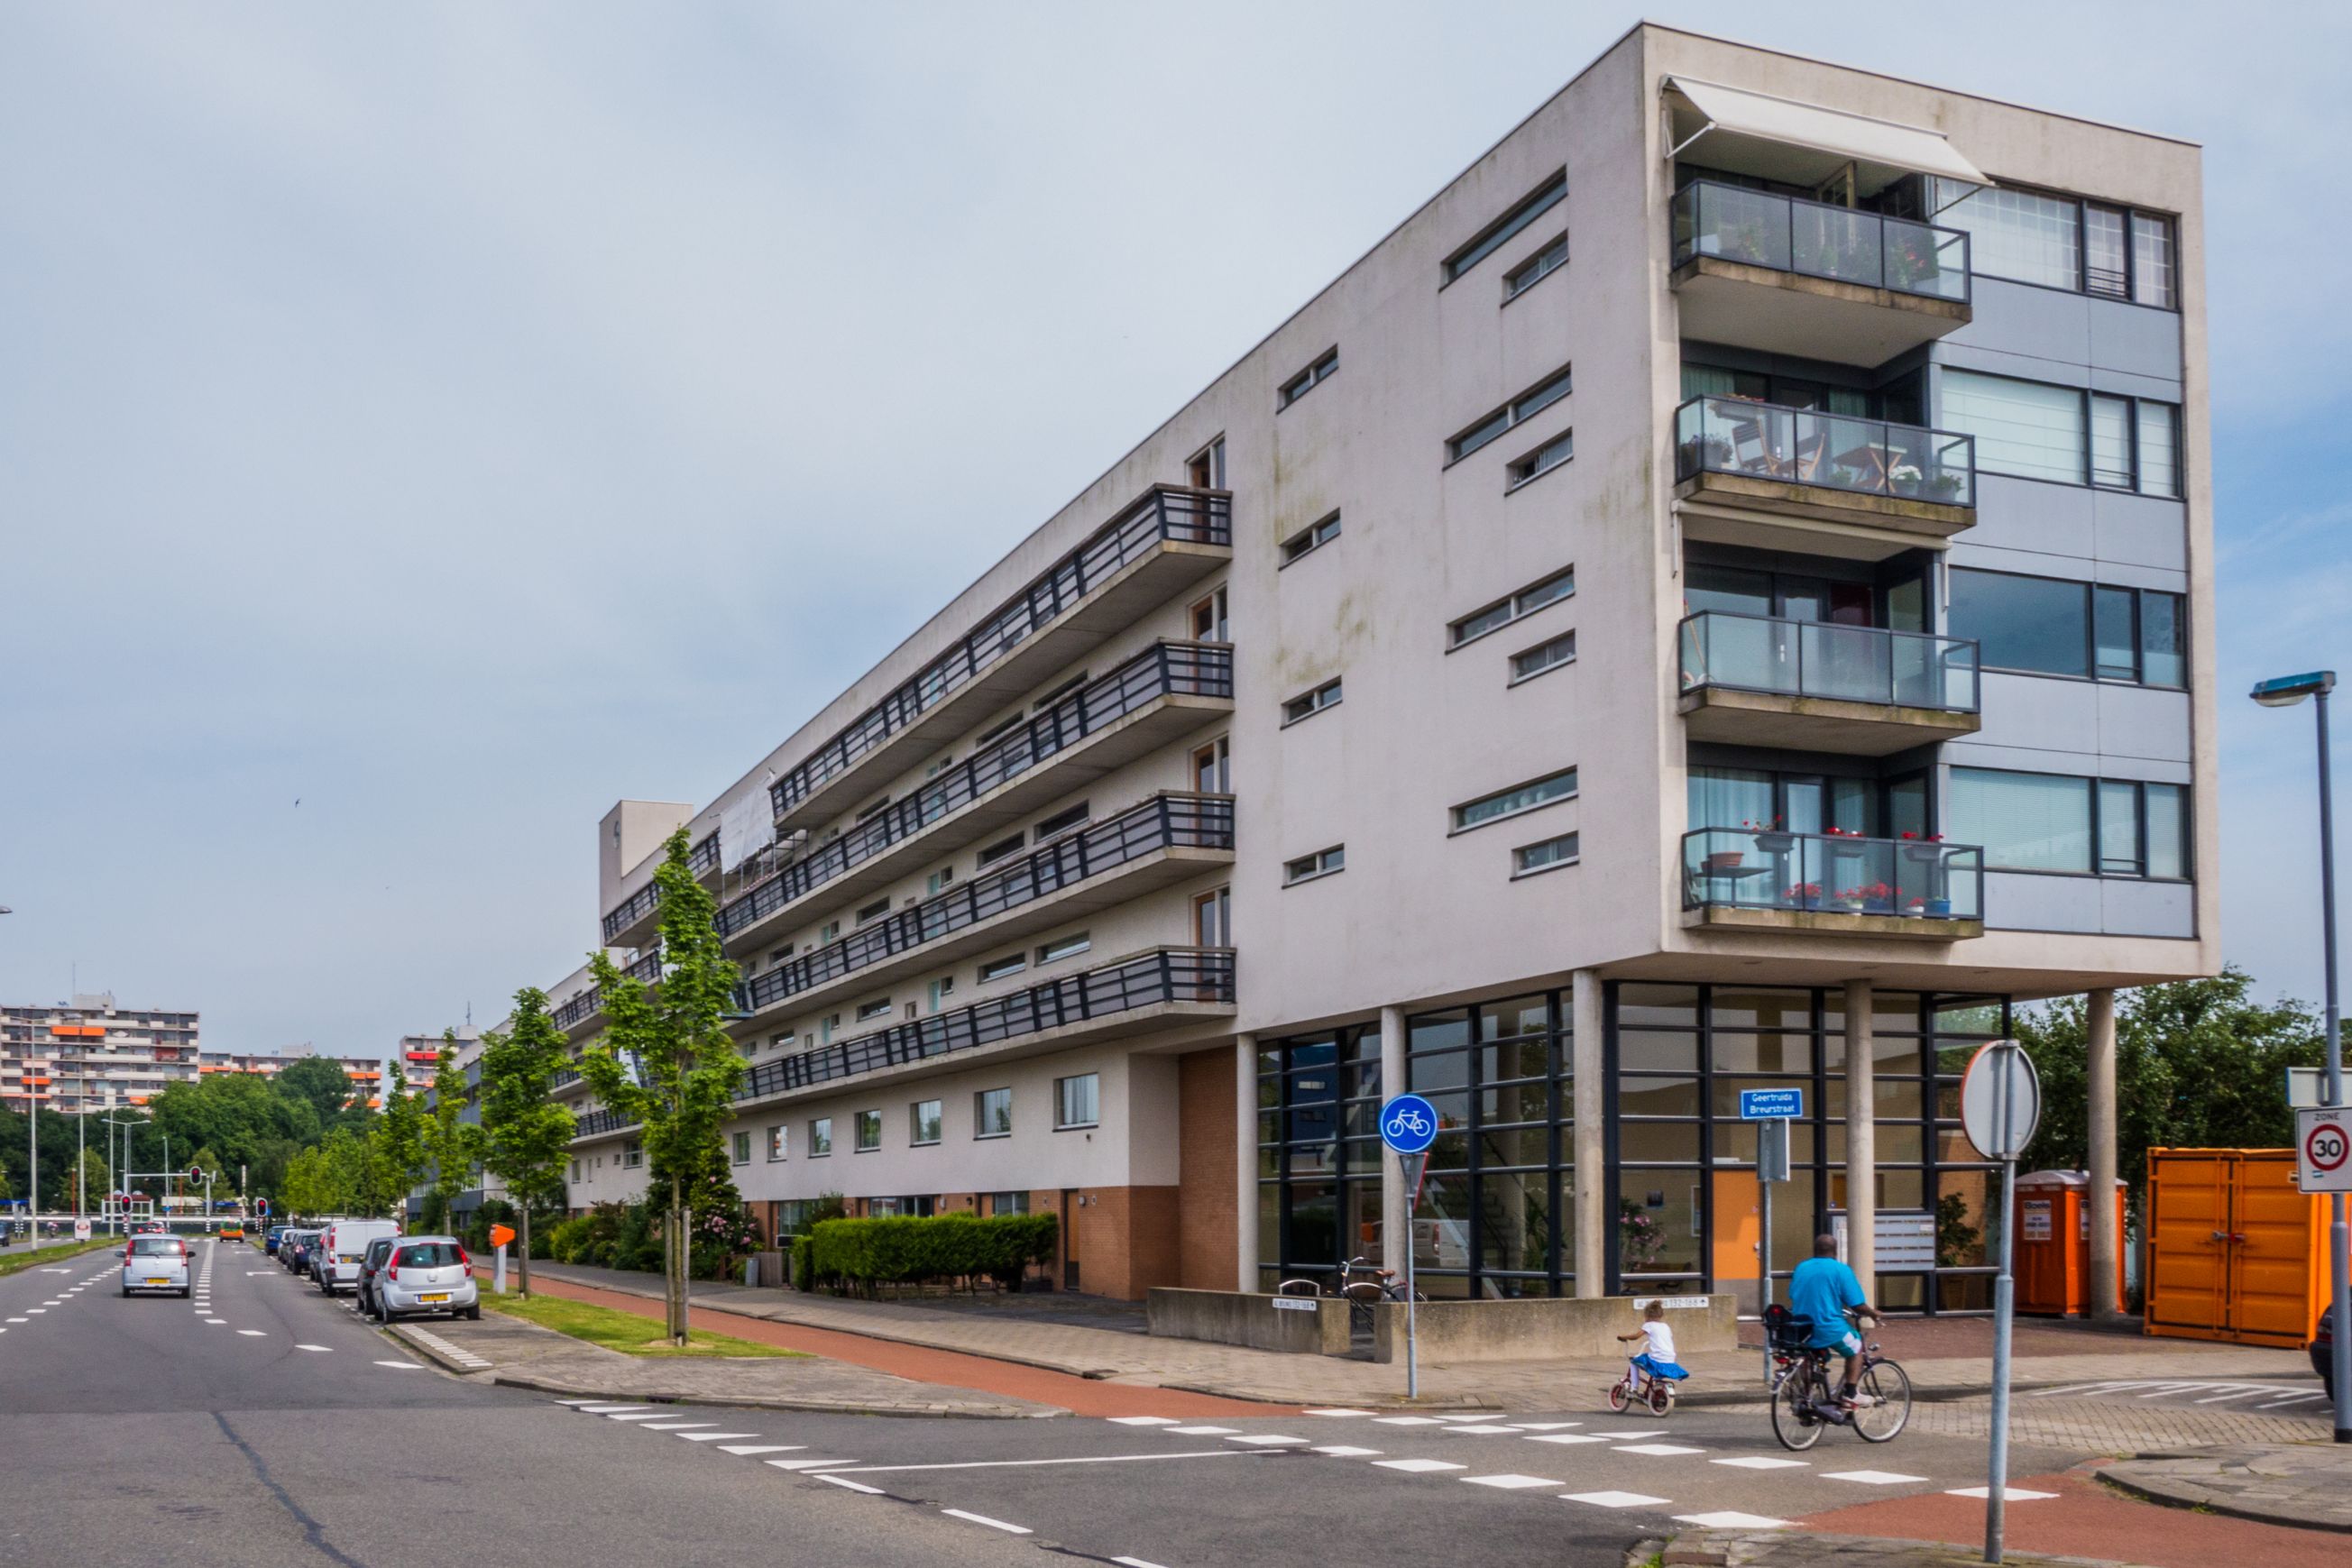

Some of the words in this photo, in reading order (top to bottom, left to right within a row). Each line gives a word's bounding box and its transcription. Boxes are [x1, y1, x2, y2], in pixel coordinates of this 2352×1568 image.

[1751, 1093, 1793, 1102] Geertruida
[2314, 1112, 2340, 1121] ZONE
[2314, 1139, 2341, 1157] 30
